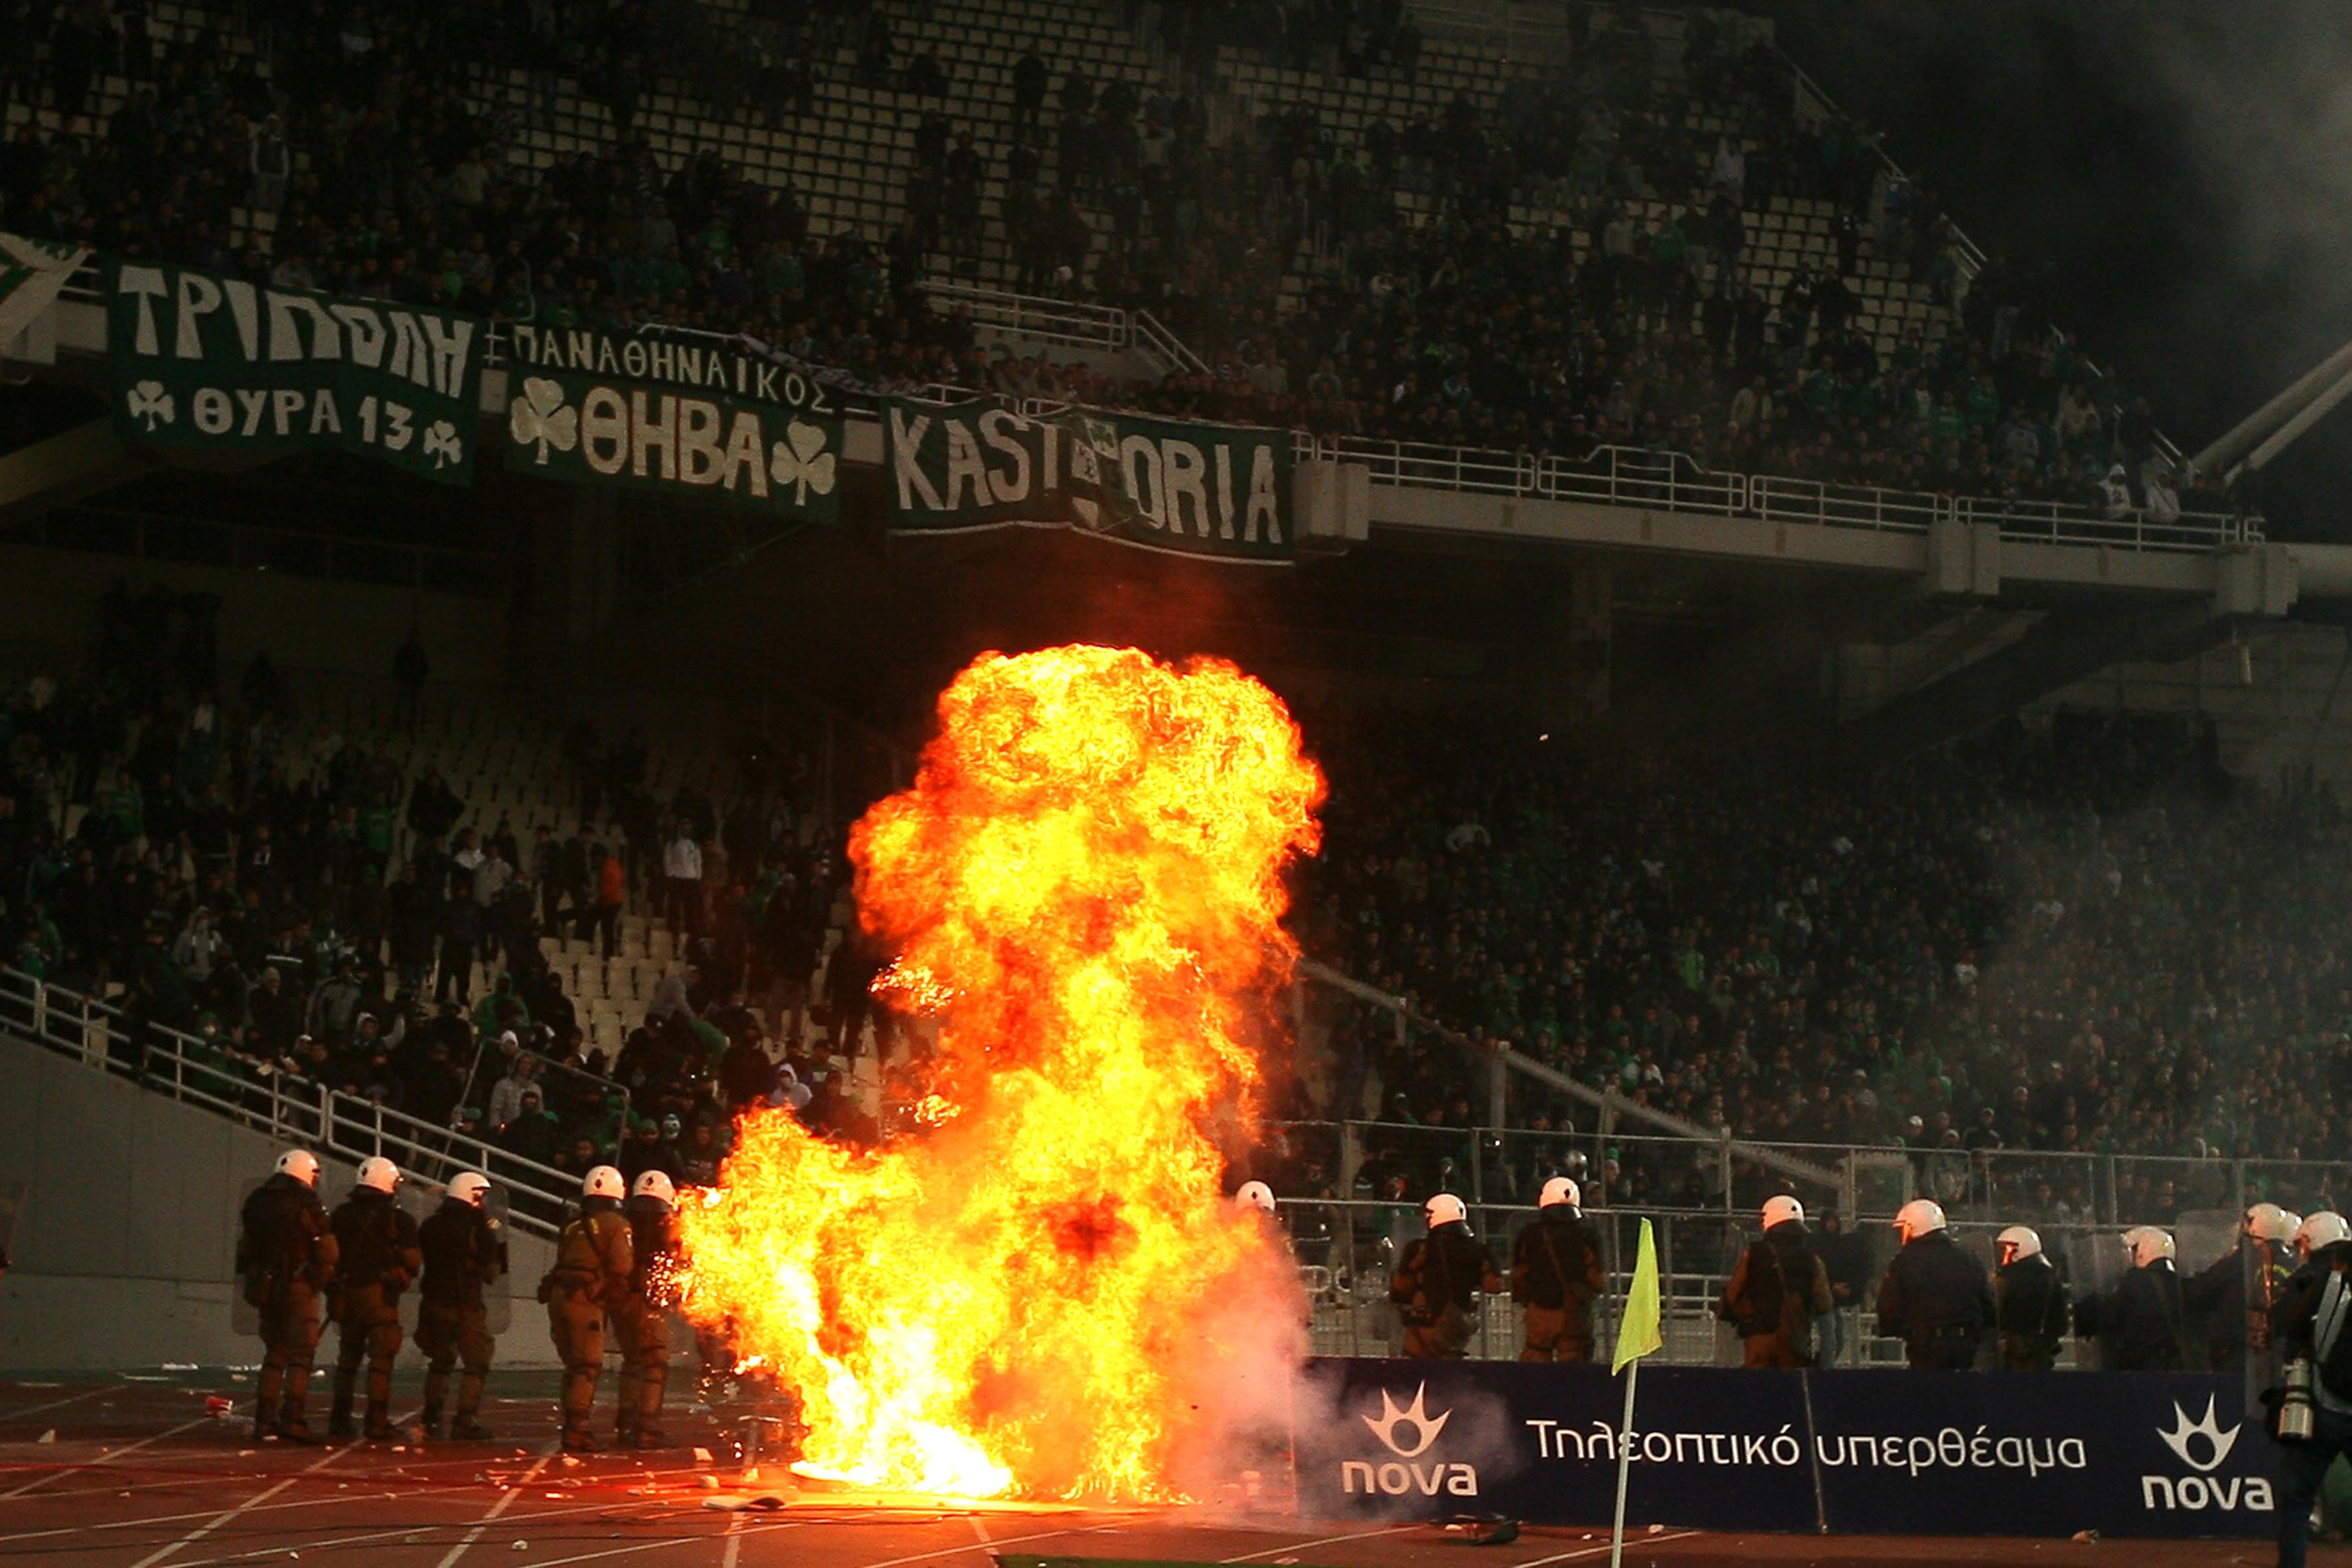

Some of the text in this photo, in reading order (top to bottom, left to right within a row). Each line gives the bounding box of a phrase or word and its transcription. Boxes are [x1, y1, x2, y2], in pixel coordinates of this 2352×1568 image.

[119, 265, 474, 398] ΤΡΙΠΟΛΗ
[193, 387, 414, 451] ΘΥΡΑ 13
[581, 385, 769, 498] ΘΗΒΑ
[1341, 1460, 1478, 1497] nova
[1525, 1419, 2087, 1477] Τηλεοπτικό υπερθέαμα
[2140, 1474, 2276, 1512] nova
